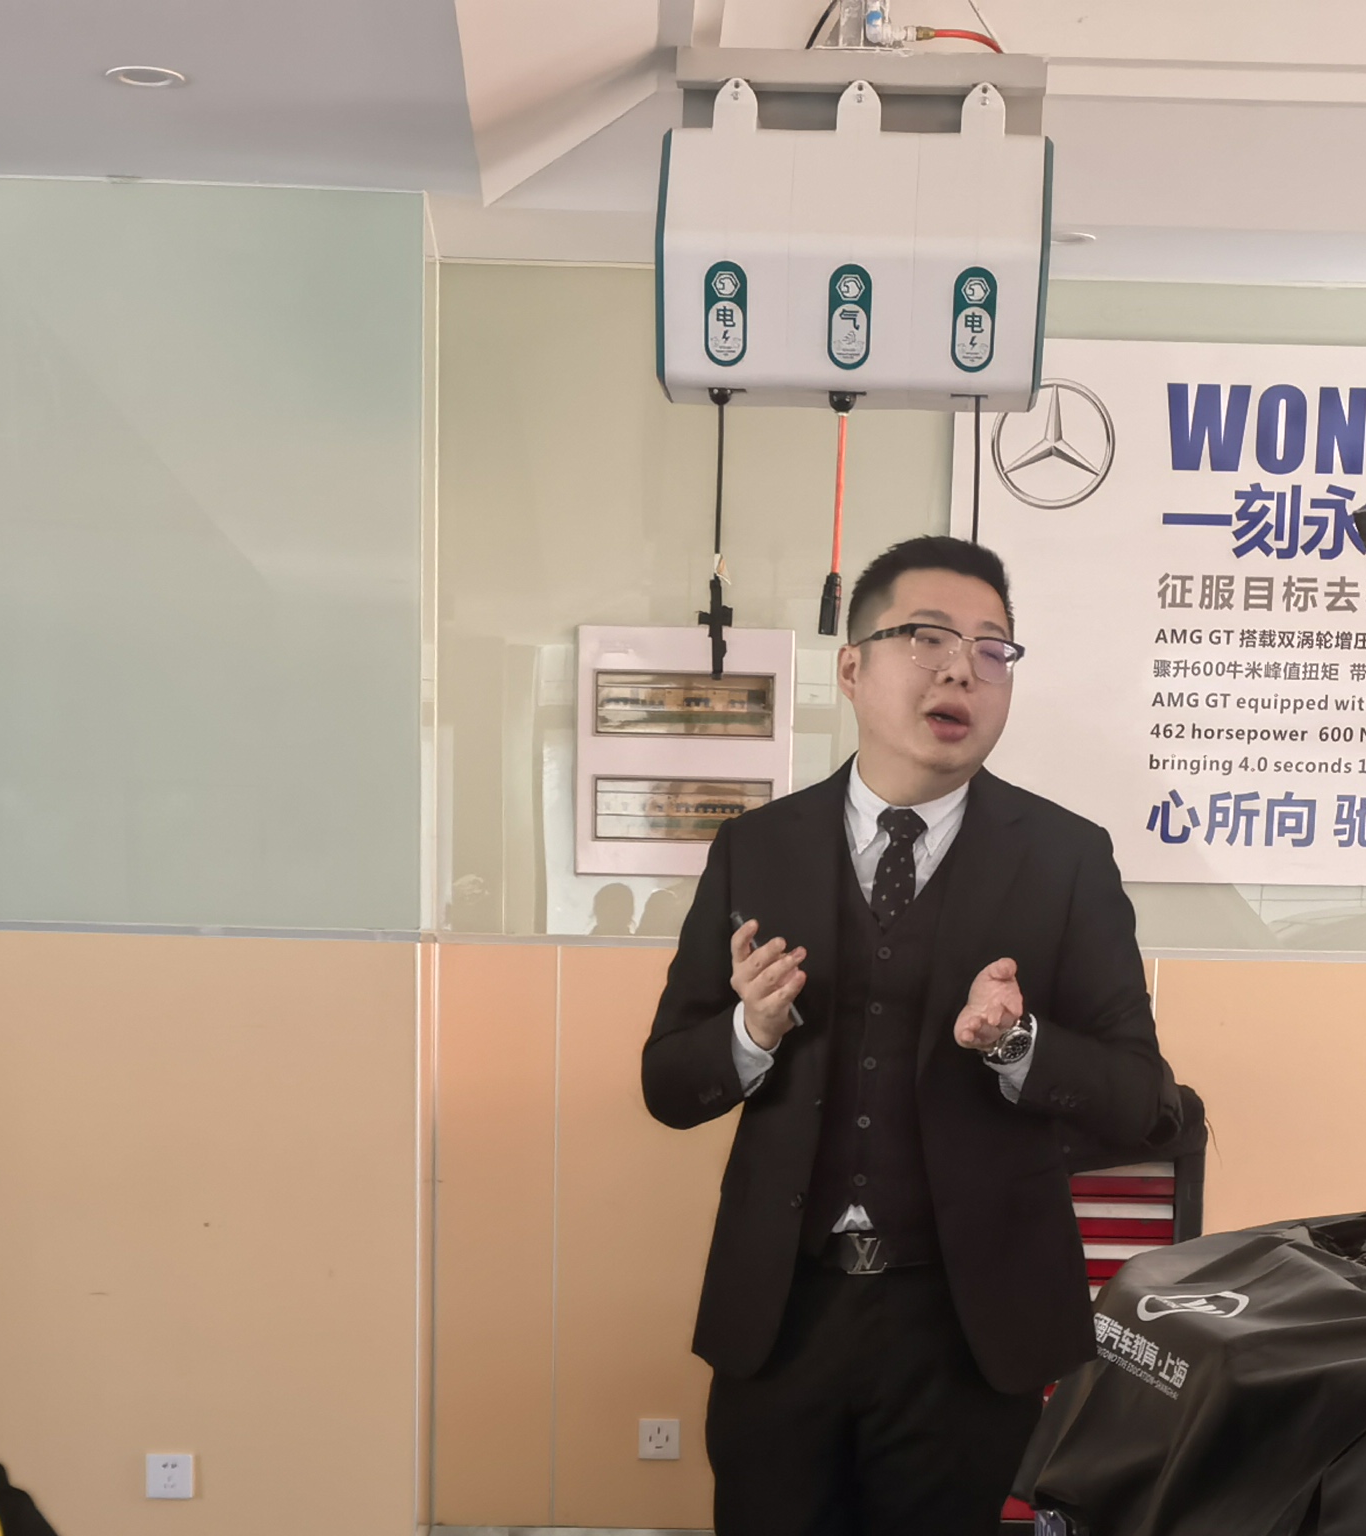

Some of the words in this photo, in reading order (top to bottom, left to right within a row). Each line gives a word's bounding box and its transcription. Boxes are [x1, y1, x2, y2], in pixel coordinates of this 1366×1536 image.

[716, 306, 735, 327] 电
[839, 308, 860, 331] 气
[964, 311, 984, 333] 电
[1155, 629, 1203, 645] AMG
[1208, 630, 1234, 645] GT
[1153, 660, 1340, 681] 骤升600牛米峰值扭矩
[1152, 693, 1199, 708] AMG
[1205, 693, 1230, 709] GT
[1236, 694, 1328, 714] equipped
[1150, 723, 1185, 739] 462
[1191, 724, 1308, 744] horsepower
[1318, 727, 1353, 743] 600
[1149, 755, 1233, 775] bringing
[1238, 757, 1268, 773] 4.0
[1273, 758, 1352, 774] seconds
[1146, 789, 1316, 847] 心所向
